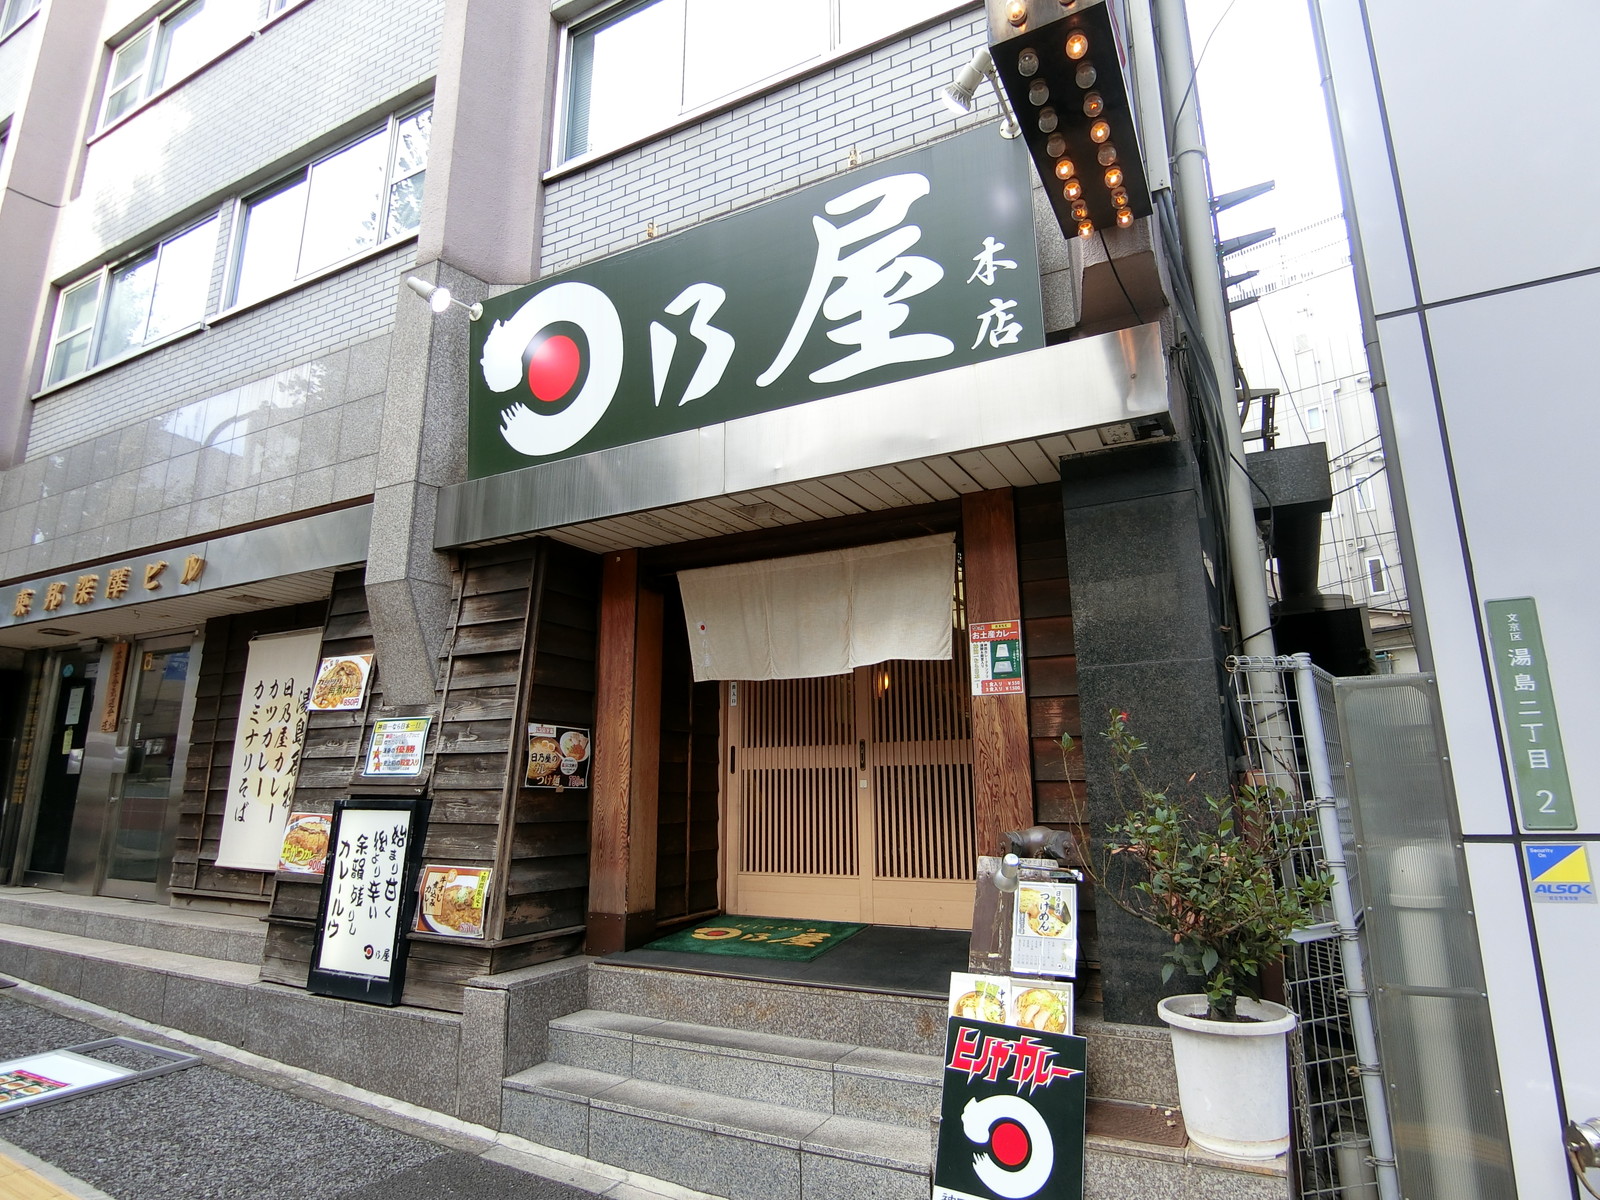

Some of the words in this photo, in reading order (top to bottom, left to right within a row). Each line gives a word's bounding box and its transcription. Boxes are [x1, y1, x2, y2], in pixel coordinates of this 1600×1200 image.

[966, 236, 1020, 350] 本店
[1505, 613, 1523, 642] 文京区
[234, 680, 266, 824] カミナリそば
[257, 679, 278, 798] カツカレー
[268, 677, 295, 824] 日乃屋カレー
[1507, 647, 1550, 770] 湯島二丁目
[1535, 789, 1557, 814] 2
[327, 839, 350, 938] カレールウ
[367, 830, 388, 920] 後より辛い
[384, 824, 407, 919] 始まり甘く
[1038, 893, 1050, 932] つけめん
[1534, 883, 1593, 895] ALSOK
